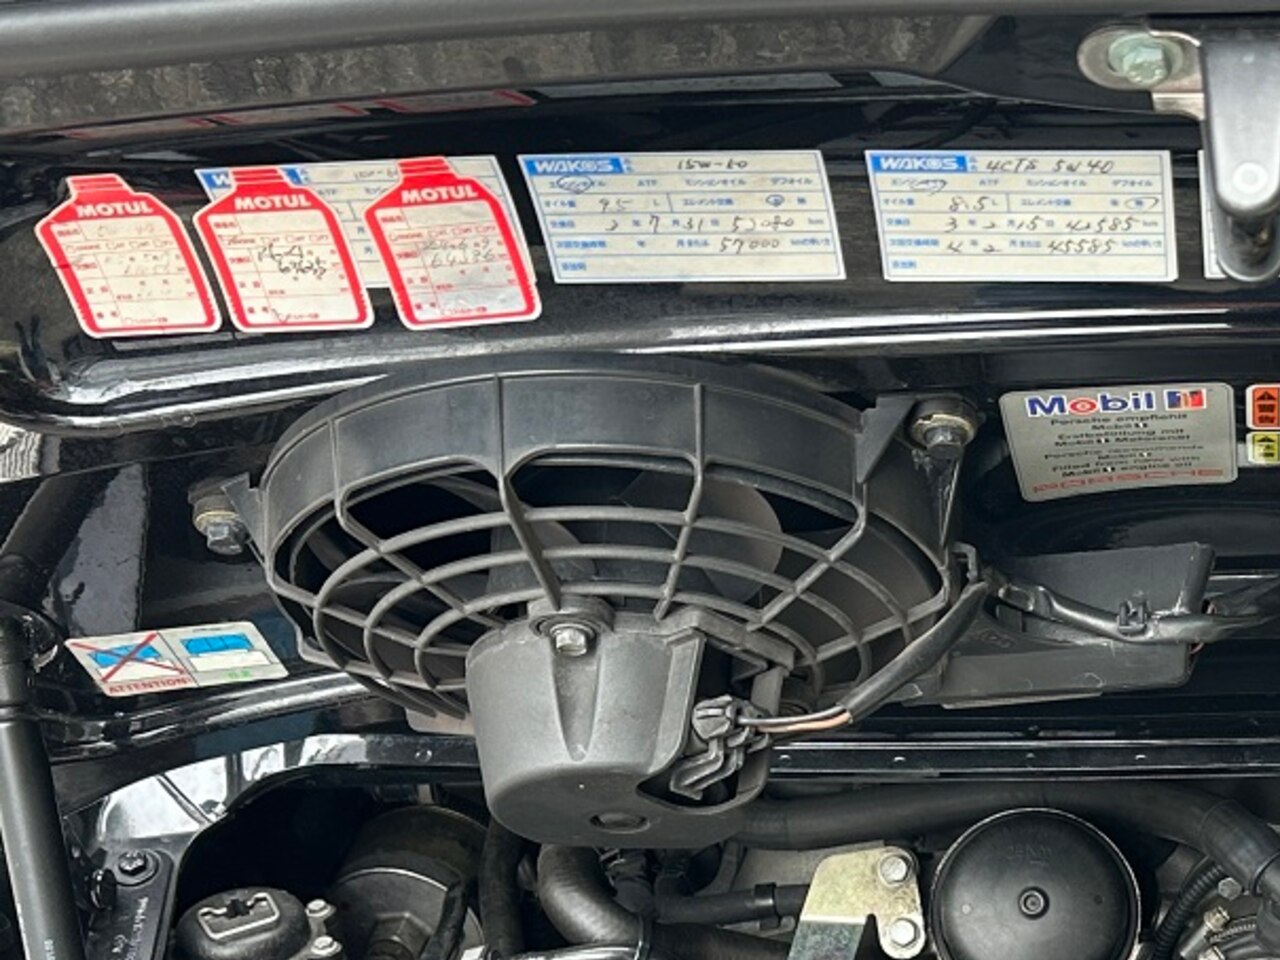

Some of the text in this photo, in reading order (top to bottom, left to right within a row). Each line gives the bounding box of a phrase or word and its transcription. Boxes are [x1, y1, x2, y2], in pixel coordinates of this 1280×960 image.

[234, 195, 312, 211] MOTUL
[401, 185, 478, 203] MOTUL
[76, 201, 153, 217] MOTUL
[1027, 392, 1154, 416] Mobil
[1033, 469, 1224, 494] PORSCHE
